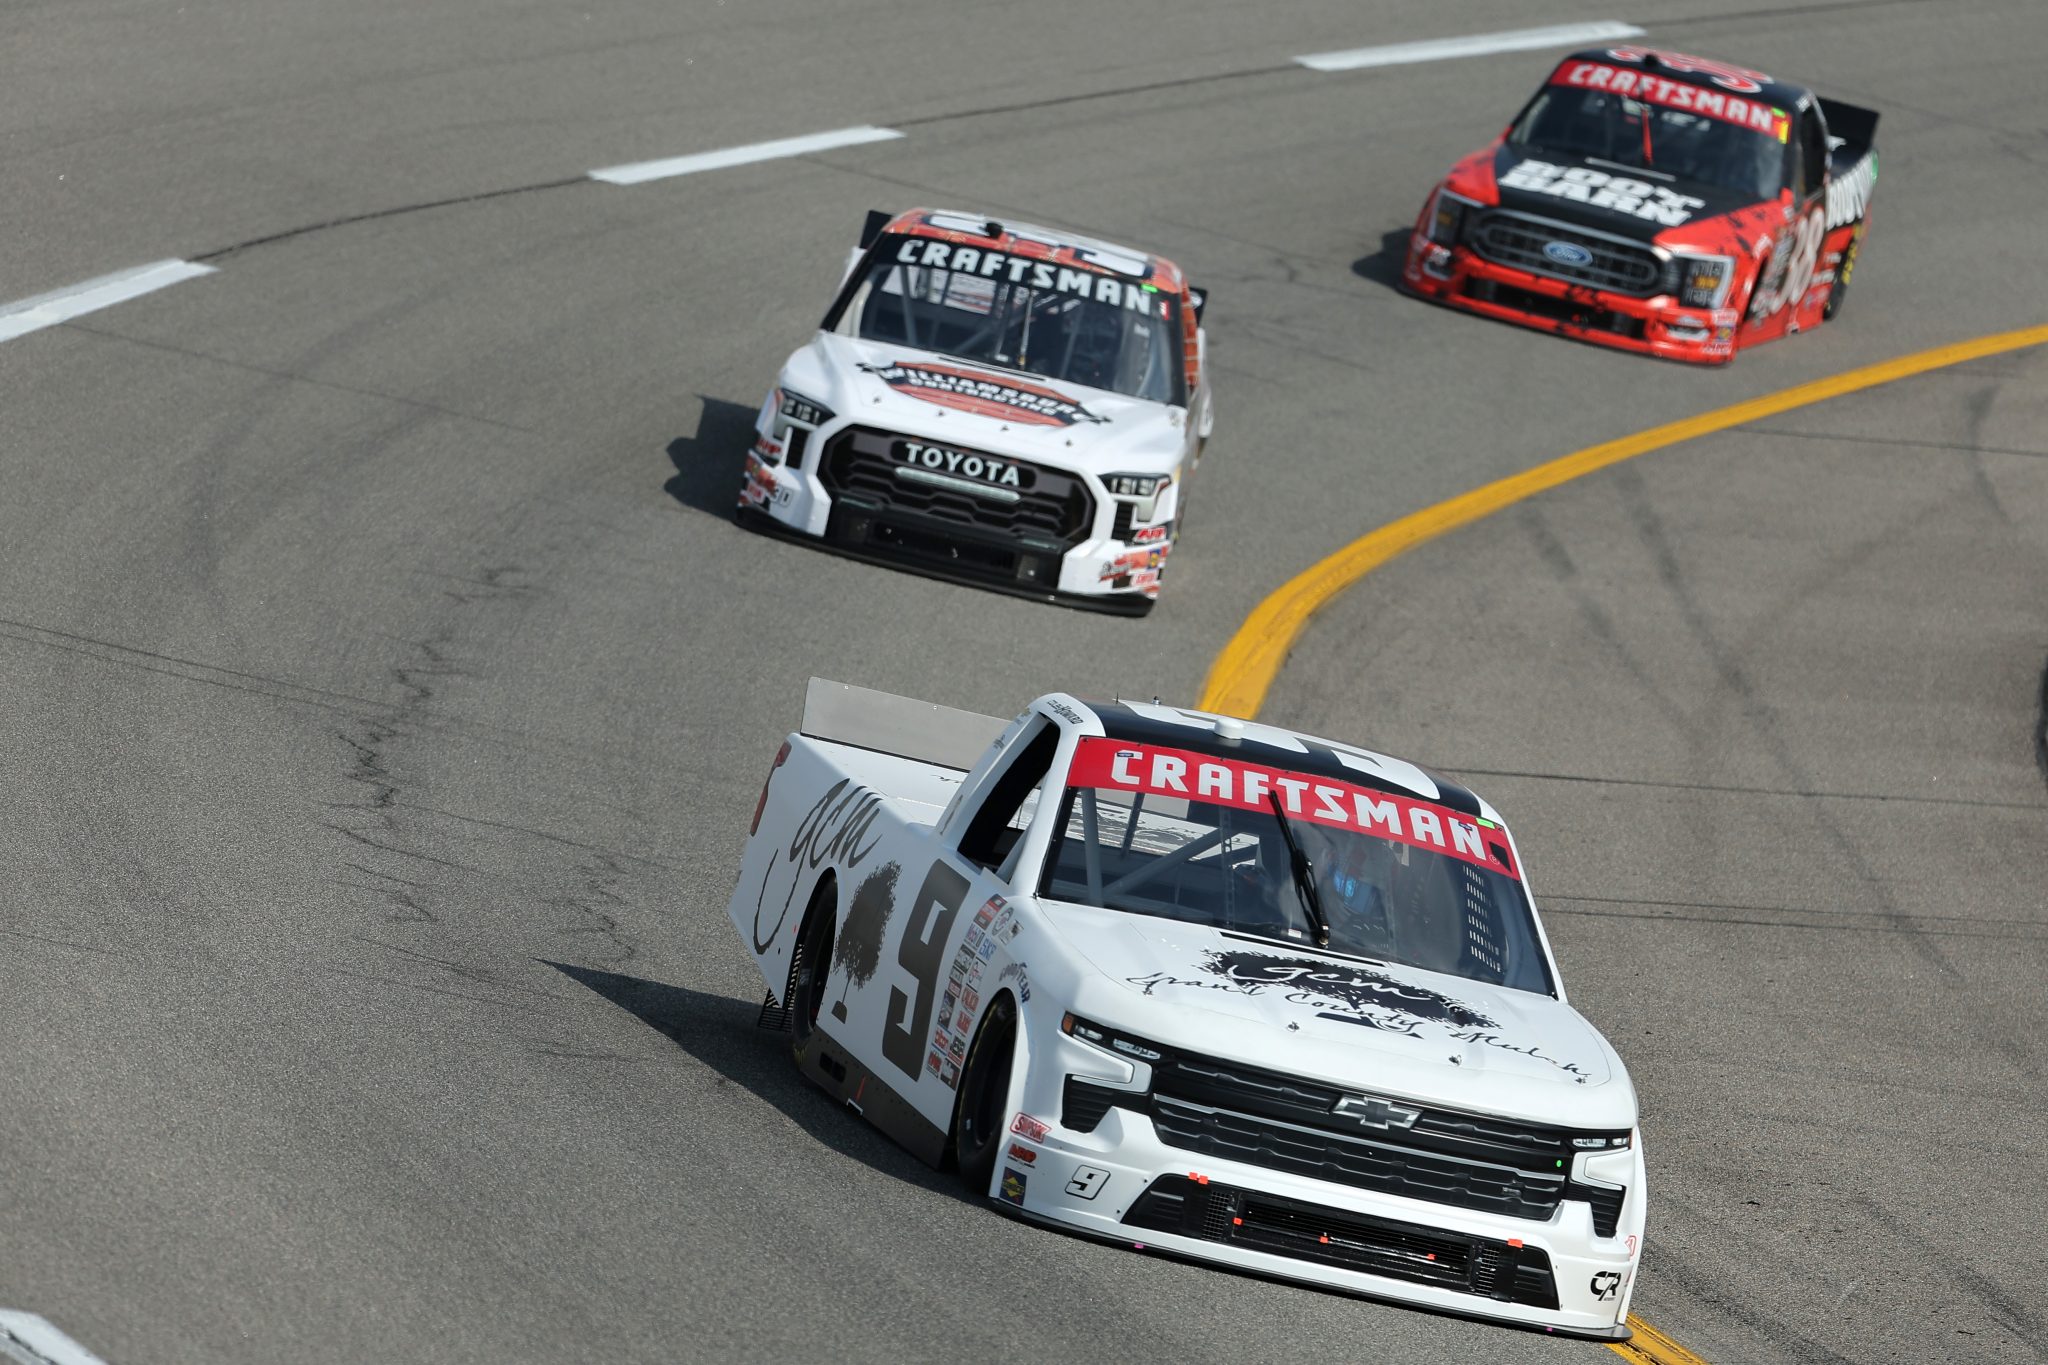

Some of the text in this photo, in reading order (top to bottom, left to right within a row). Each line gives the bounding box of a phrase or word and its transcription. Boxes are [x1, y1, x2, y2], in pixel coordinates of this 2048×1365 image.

[1567, 63, 1773, 130] CRAFTSMAN
[1501, 173, 1692, 227] BARN
[896, 240, 1151, 315] CRAFTSMAN
[905, 444, 1020, 487] TOYOTA
[1111, 749, 1487, 861] CRAFTSMAN
[881, 858, 971, 1082] 9
[1285, 993, 1425, 1034] County
[1449, 1032, 1592, 1076] Mulch
[1064, 1164, 1111, 1201] 9
